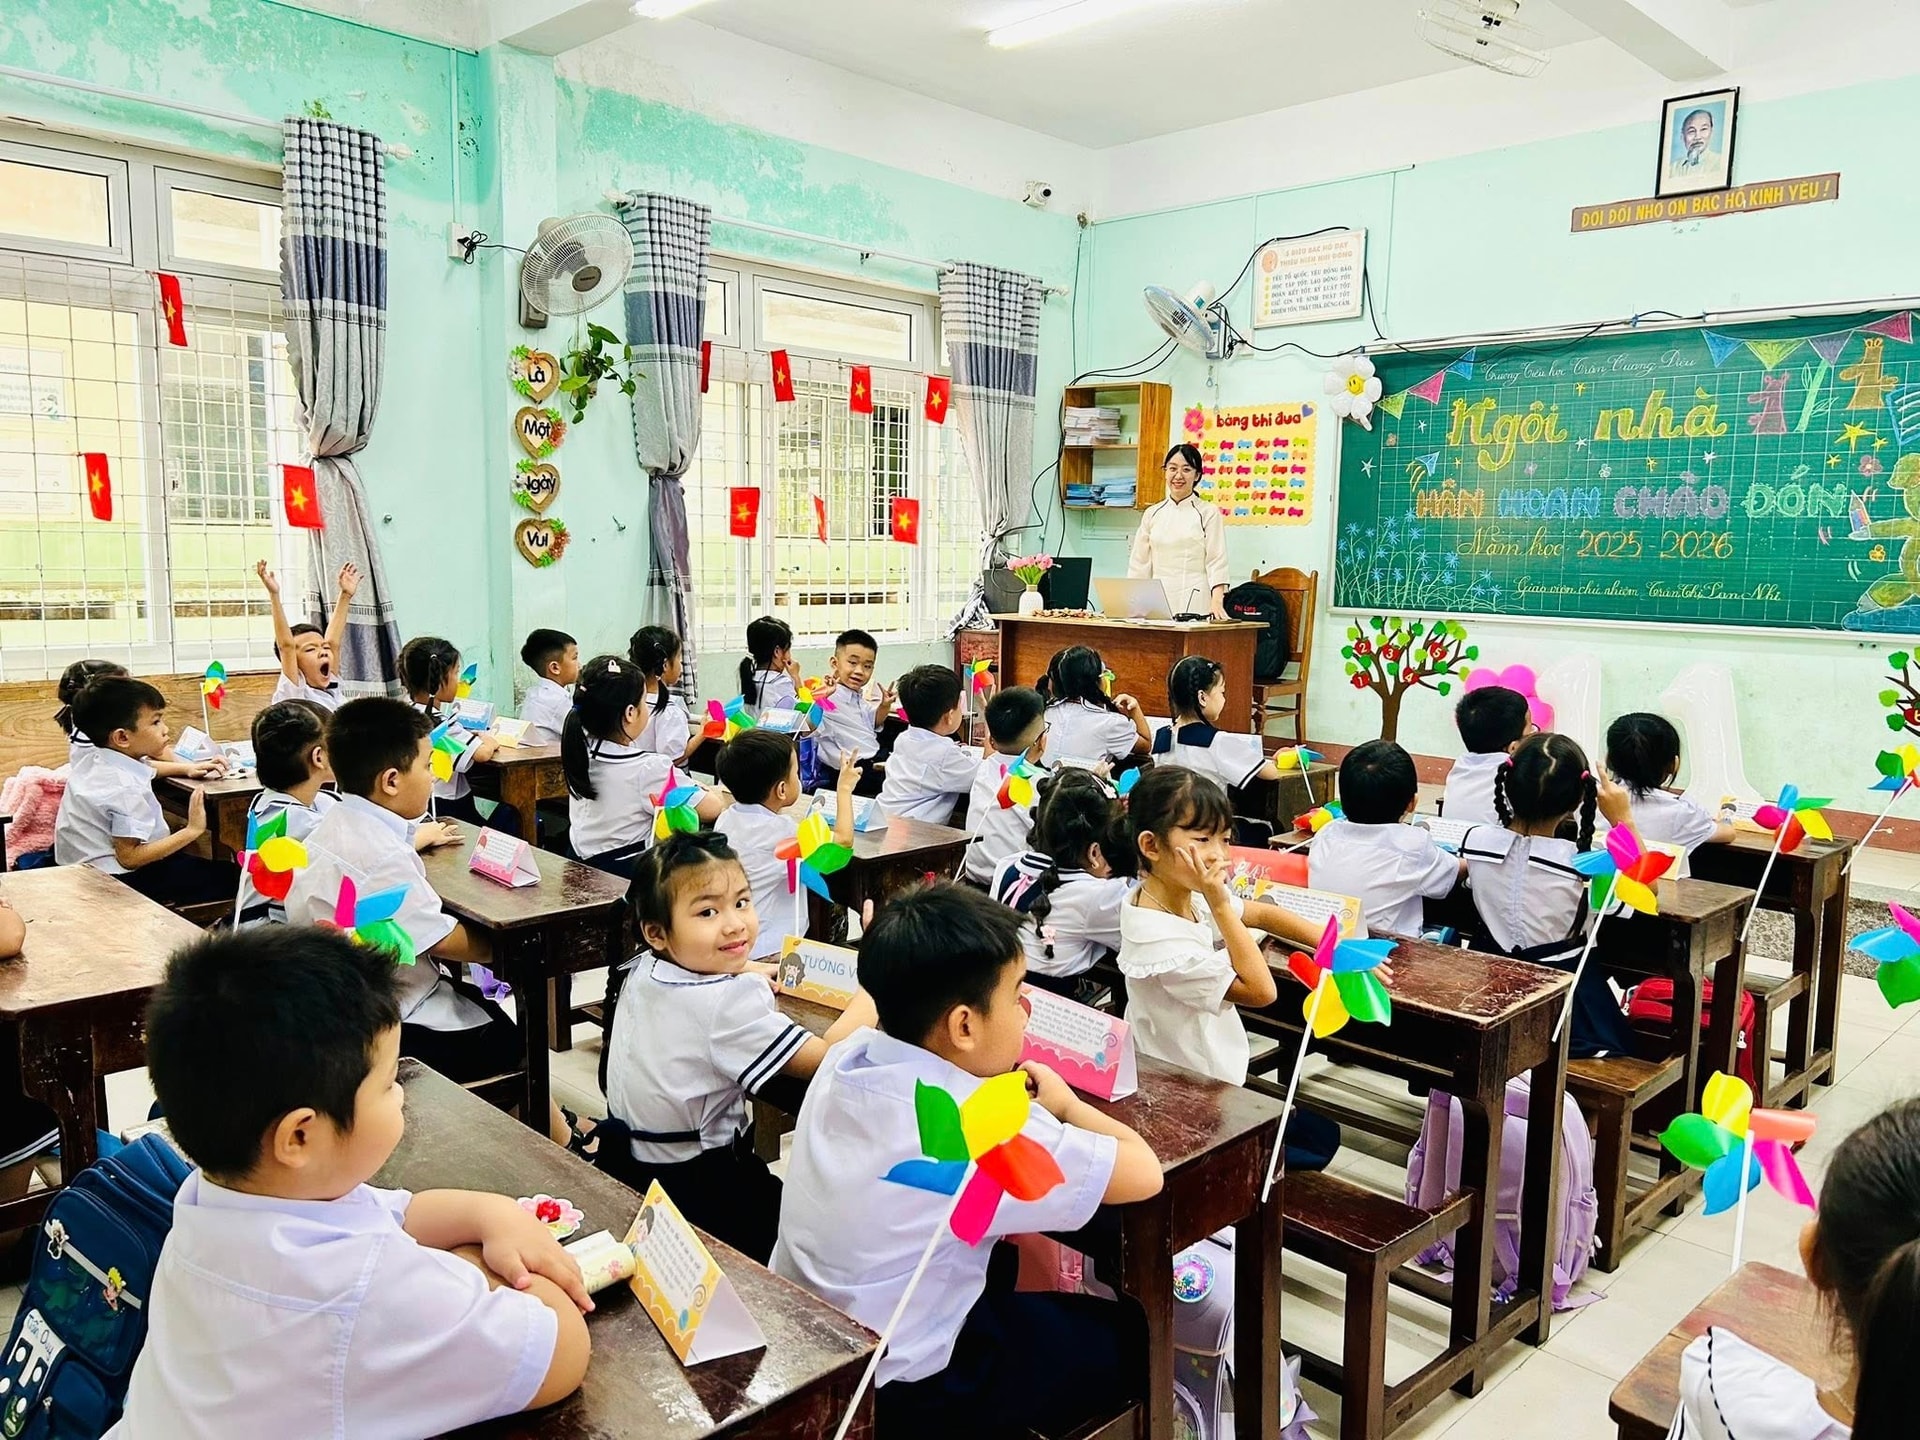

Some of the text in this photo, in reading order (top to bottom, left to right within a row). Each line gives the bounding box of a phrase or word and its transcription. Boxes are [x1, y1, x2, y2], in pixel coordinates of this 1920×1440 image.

[528, 365, 546, 383] Là
[524, 418, 551, 440] Một
[1216, 413, 1249, 431] bảng
[1252, 412, 1272, 427] thi
[1447, 397, 1569, 472] Ngôi
[1593, 386, 1729, 442] nhà
[1416, 463, 1848, 521] HÂN HOAN CHÀO ĐÓN
[527, 530, 549, 548] Vui
[1457, 525, 1522, 556] Năm
[1523, 525, 1564, 558] học
[1577, 530, 1643, 559] 2025
[1660, 530, 1734, 559] 2026
[1511, 575, 1548, 600] Giáo
[1549, 583, 1577, 595] viên
[1603, 579, 1640, 597] nhiệm
[1703, 581, 1741, 600] Lan
[1359, 643, 1367, 653] 2
[1385, 648, 1394, 657] 3
[1433, 647, 1442, 658] 5
[1358, 675, 1365, 687] 1
[1404, 672, 1414, 682] 4
[803, 953, 858, 979] TƯỜNG V
